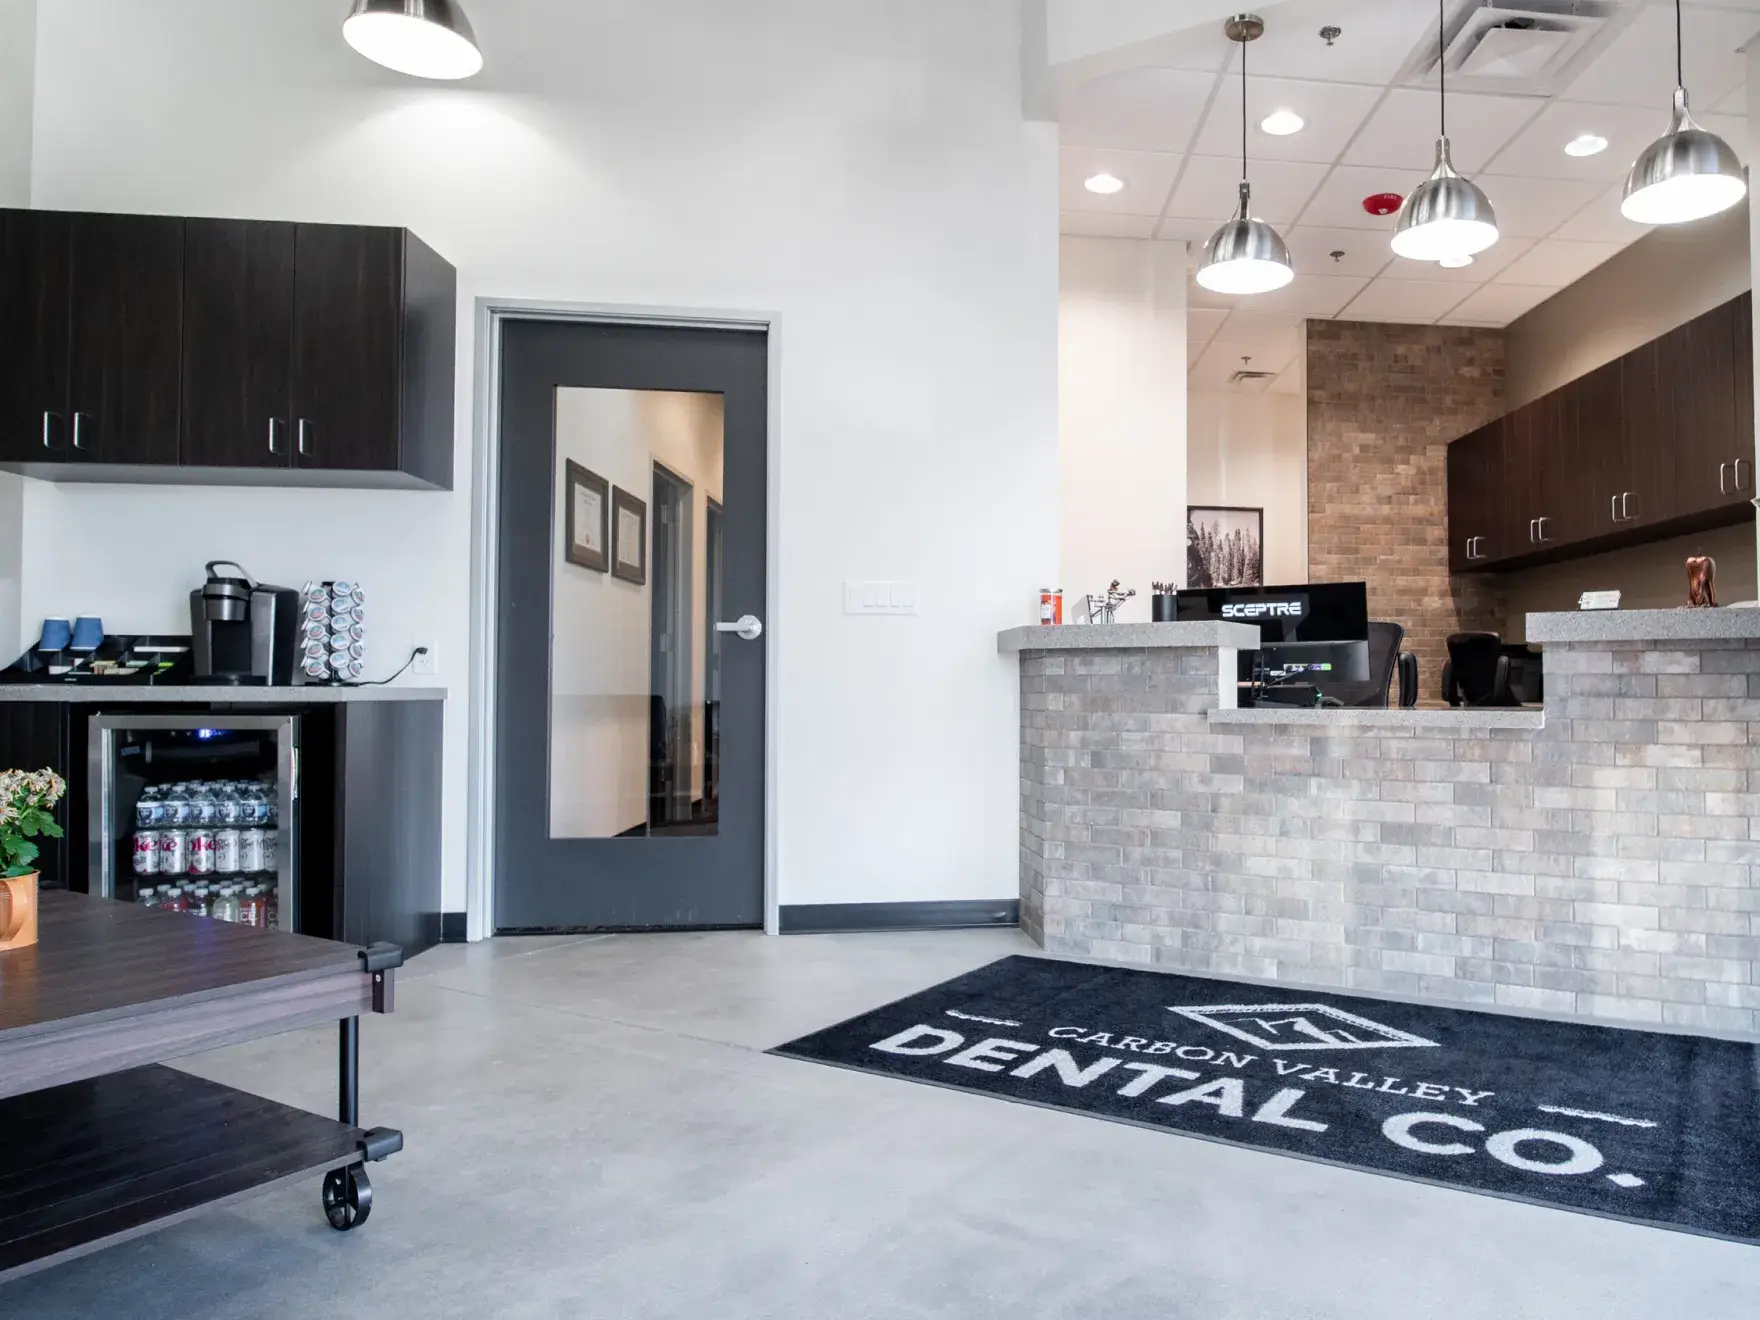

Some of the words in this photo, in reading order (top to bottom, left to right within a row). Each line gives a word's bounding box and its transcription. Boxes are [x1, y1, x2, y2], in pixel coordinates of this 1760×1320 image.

[1221, 601, 1302, 618] SCEPTRE
[868, 1023, 1329, 1133] DENTAL
[1382, 1111, 1645, 1188] CO.
[1048, 1026, 1258, 1069] CARBON
[1272, 1058, 1495, 1106] VALLEY
